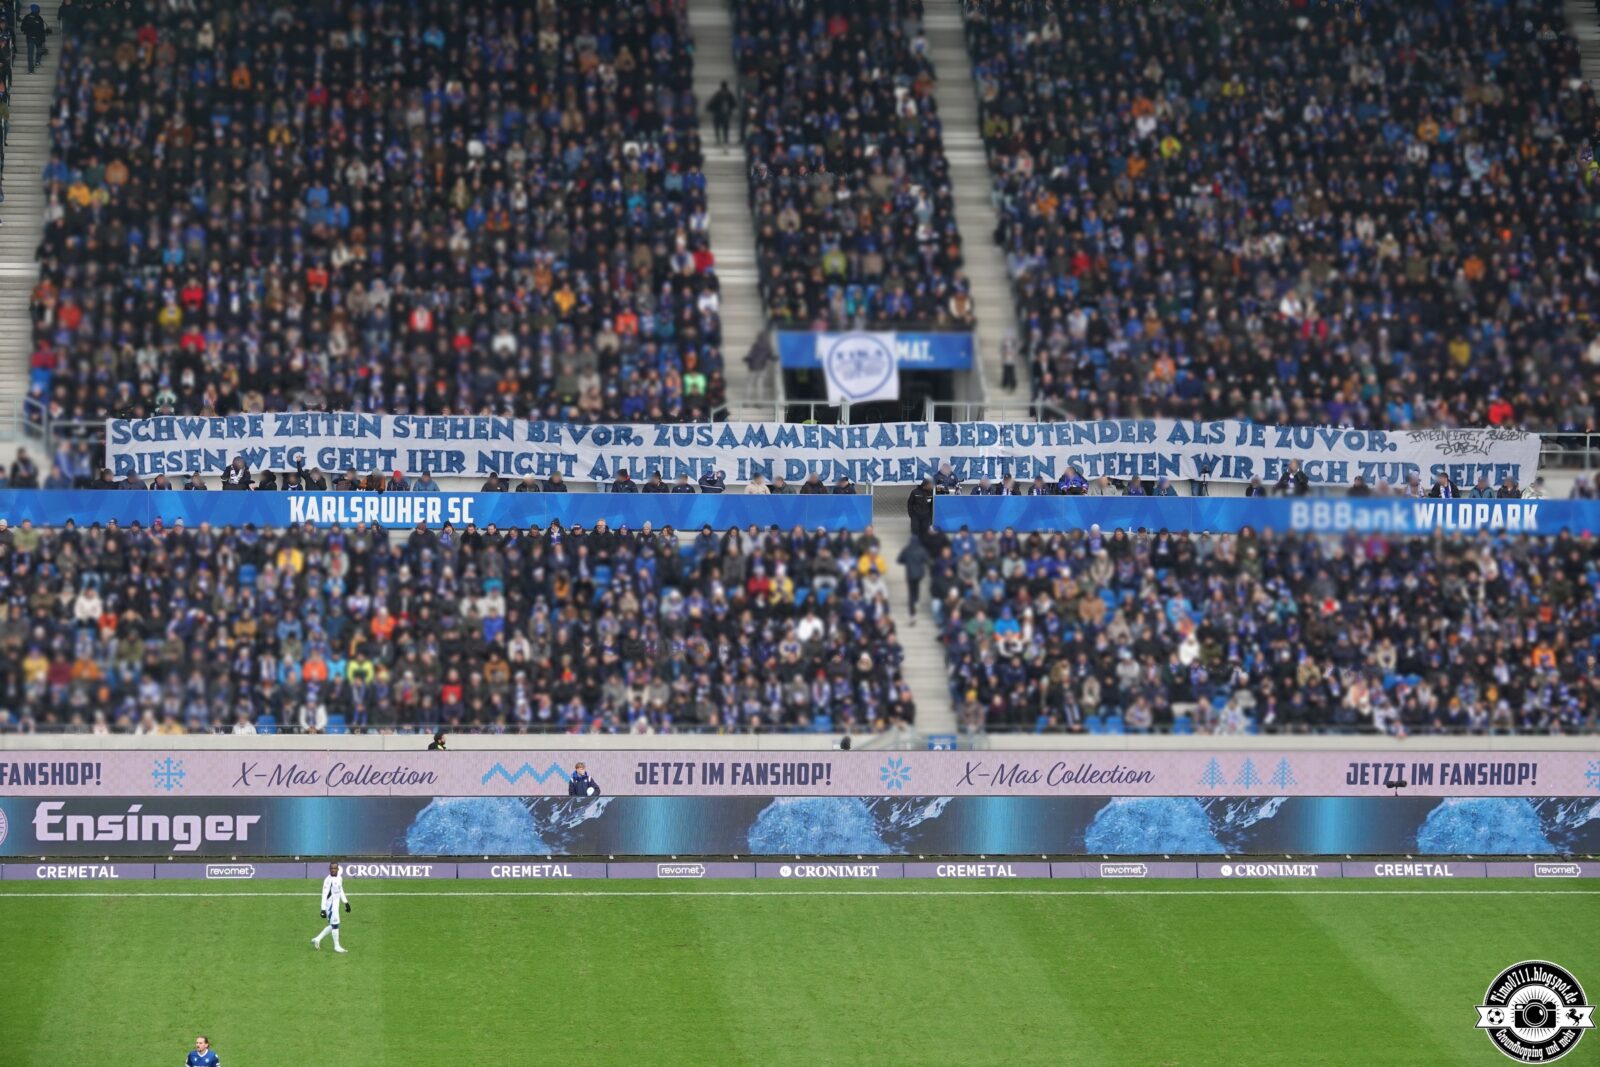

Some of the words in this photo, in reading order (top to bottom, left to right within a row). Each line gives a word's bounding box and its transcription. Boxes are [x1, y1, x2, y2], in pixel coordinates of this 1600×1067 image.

[112, 415, 264, 444] SCHWERE
[274, 413, 382, 439] ZEITEN
[393, 415, 515, 441] STEHEN
[525, 420, 644, 446] BEVOR.
[653, 423, 929, 450] ZUSAMMENHALT
[939, 420, 1157, 447] BEDEUTENDER
[1166, 419, 1226, 445] ALS
[1235, 422, 1266, 448] JE
[1275, 426, 1397, 453] ZUVOR.
[113, 448, 228, 477] DIESEN
[238, 445, 306, 470] WEG
[317, 446, 397, 473] GEHT
[407, 449, 466, 474] IHR
[476, 450, 578, 477] NICHT
[587, 453, 716, 481] ALLEINE
[736, 457, 775, 482] IN
[784, 457, 940, 483] DUNKLEN
[950, 455, 1056, 480] ZEITEN
[1067, 452, 1182, 478] STEHEN
[1191, 452, 1254, 479] WIR
[289, 496, 441, 524] KARLSRUHER
[448, 497, 474, 524] SC
[1290, 502, 1409, 530] BBBank
[1414, 503, 1538, 530] WILDPARK
[0, 762, 102, 786] FANSHOP!
[232, 762, 321, 788] X-Mas
[325, 762, 439, 788] Collection
[634, 762, 696, 785] JETZT
[701, 762, 725, 786] IM
[731, 762, 832, 786] FANSHOP!
[955, 761, 1043, 788] X-Mas
[1046, 761, 1156, 787] Collection
[1346, 762, 1406, 786] JETZT
[1411, 762, 1434, 786] IM
[1439, 762, 1538, 786] FANSHOP!
[32, 801, 261, 851] Ensinger
[36, 865, 119, 878] CREMETAL
[209, 867, 250, 875] revomet
[346, 864, 433, 877] CRONIMET
[491, 864, 573, 878] CREMETAL
[660, 865, 700, 875] revomet
[793, 864, 880, 877] CRONIMET
[936, 864, 1017, 878] CREMETAL
[1103, 865, 1142, 875] revomet
[1234, 864, 1319, 877] CRONIMET
[1374, 863, 1454, 877] CREMETAL
[1537, 866, 1576, 876] revomet
